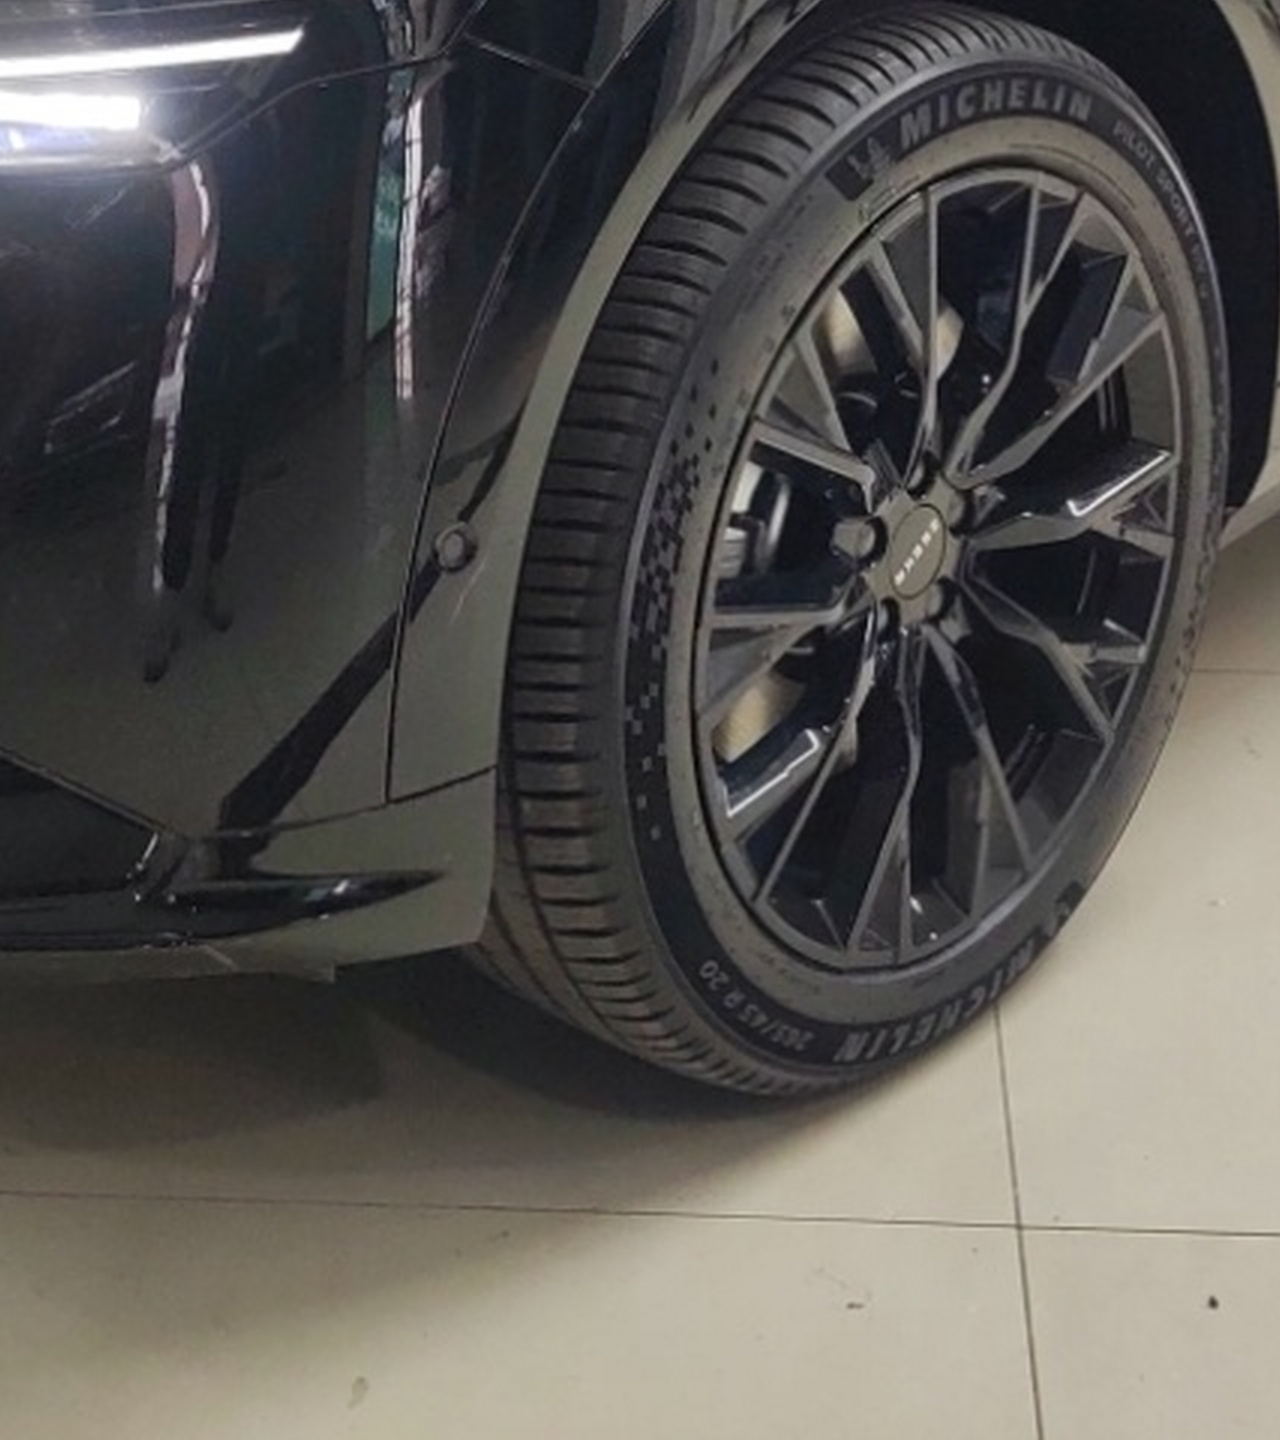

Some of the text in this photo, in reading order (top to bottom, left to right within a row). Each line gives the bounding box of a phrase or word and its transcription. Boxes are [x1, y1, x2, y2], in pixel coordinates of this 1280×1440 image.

[899, 78, 1197, 237] MICHELIN PILOT SPORT
[699, 959, 730, 992] 20
[723, 986, 747, 1010] R
[833, 940, 1038, 1062] MICHELIN
